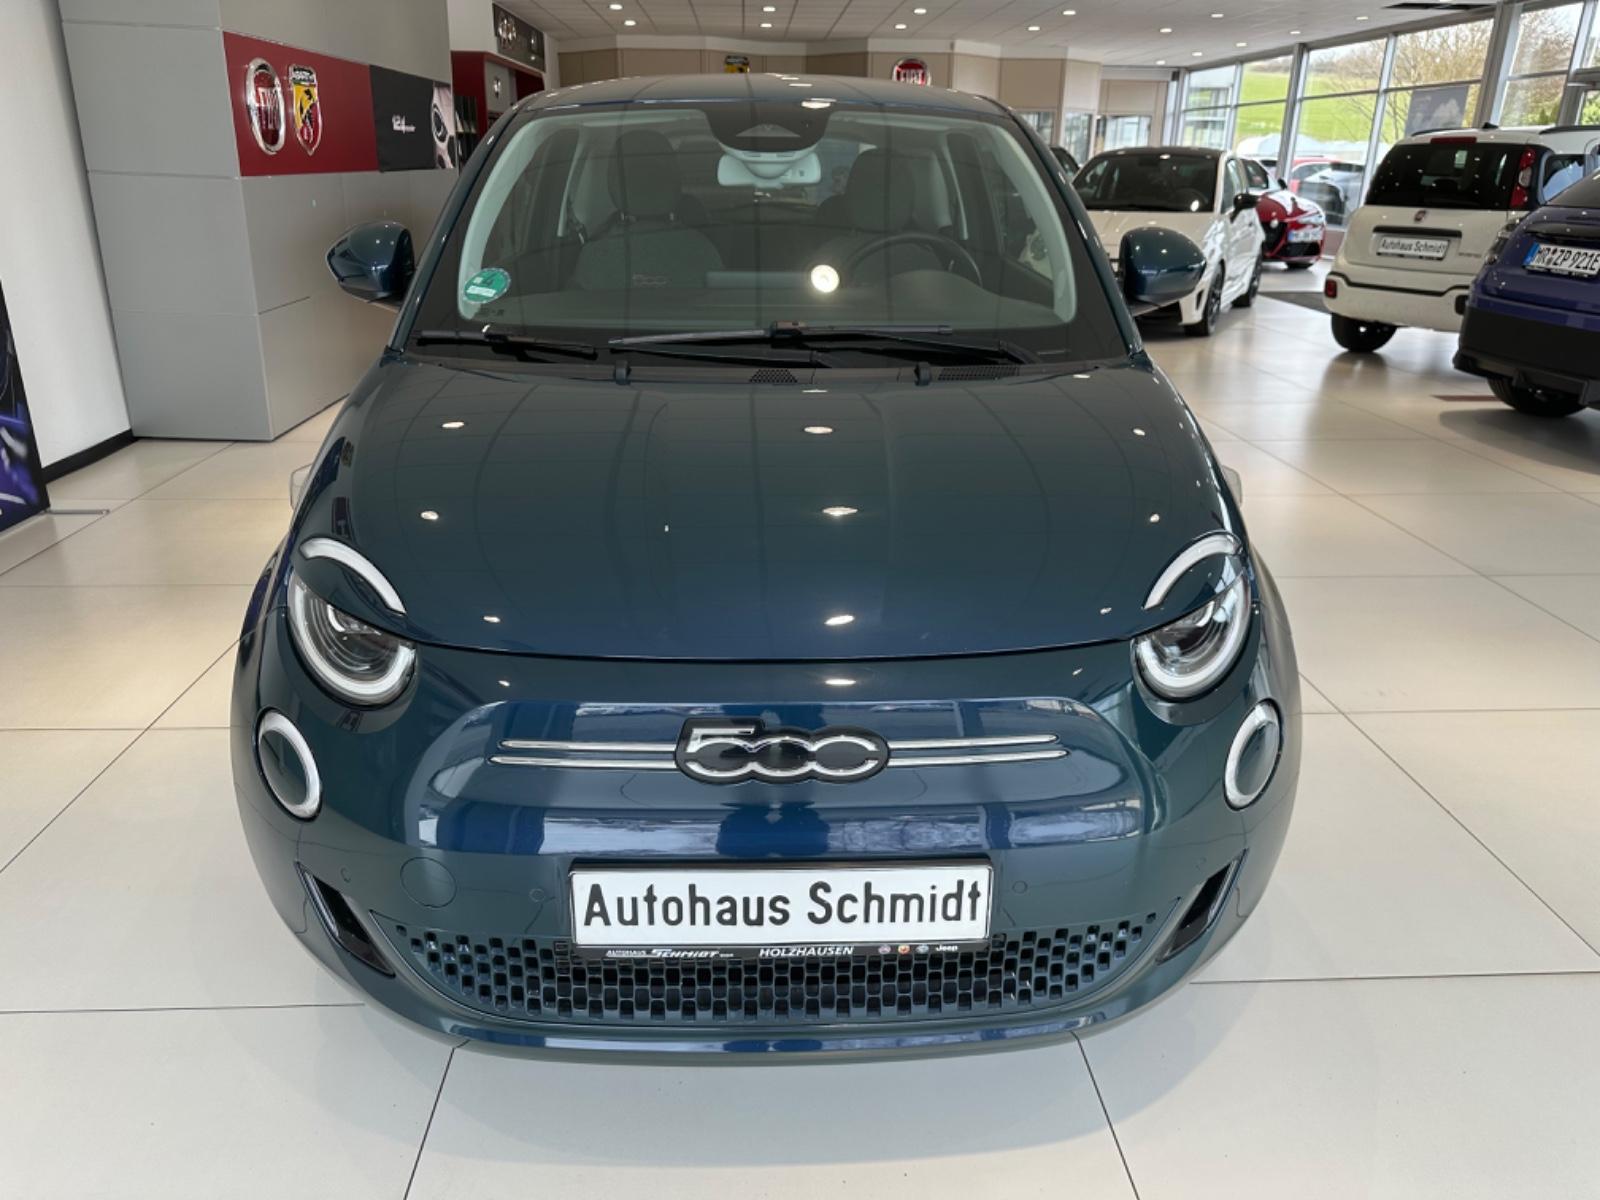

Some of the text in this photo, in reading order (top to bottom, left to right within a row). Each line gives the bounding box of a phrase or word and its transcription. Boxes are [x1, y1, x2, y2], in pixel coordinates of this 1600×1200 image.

[1382, 239, 1447, 253] Autohaus Schmidt
[682, 724, 884, 779] 500
[584, 879, 982, 927] Autohaus Schmidt
[759, 946, 855, 958] HOLZHAUSEN
